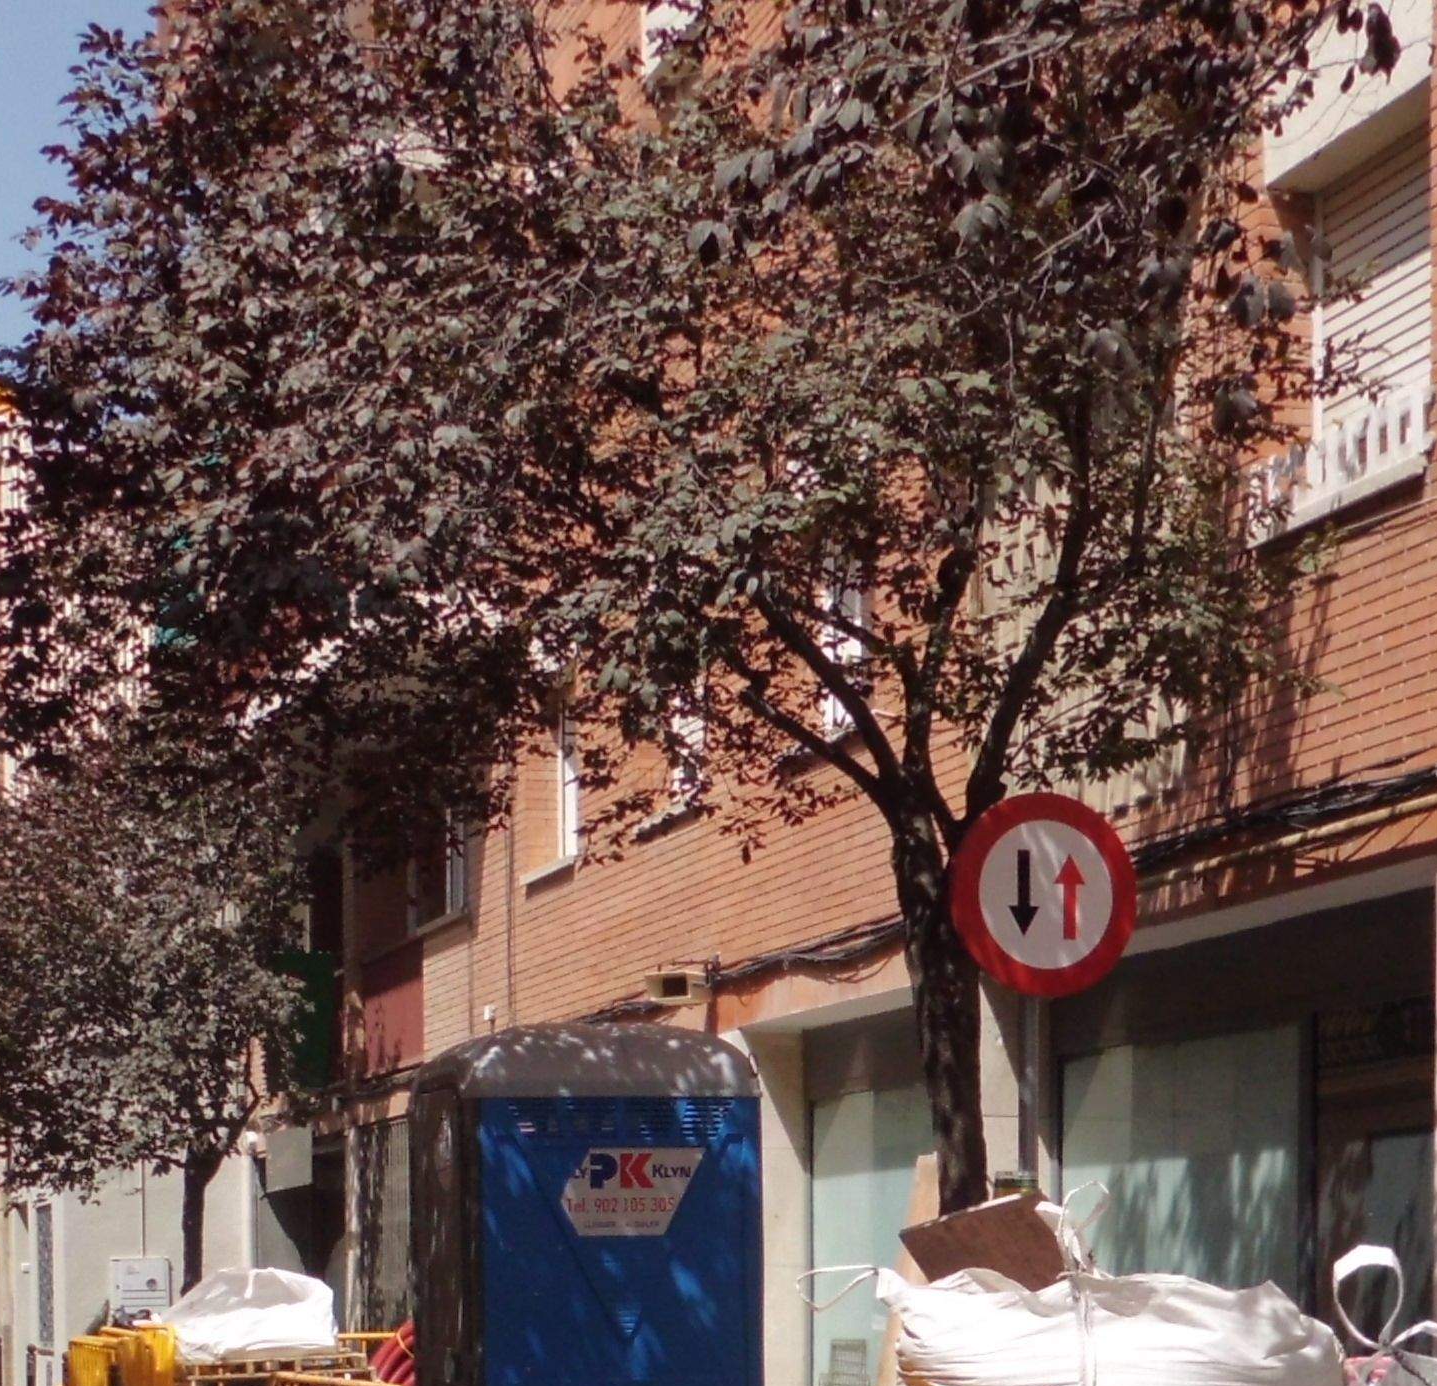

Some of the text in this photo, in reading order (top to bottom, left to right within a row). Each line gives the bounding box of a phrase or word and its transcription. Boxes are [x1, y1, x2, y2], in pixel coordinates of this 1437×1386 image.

[594, 1198, 618, 1213] 902
[624, 1197, 646, 1213] 105
[651, 1197, 675, 1212] 305
